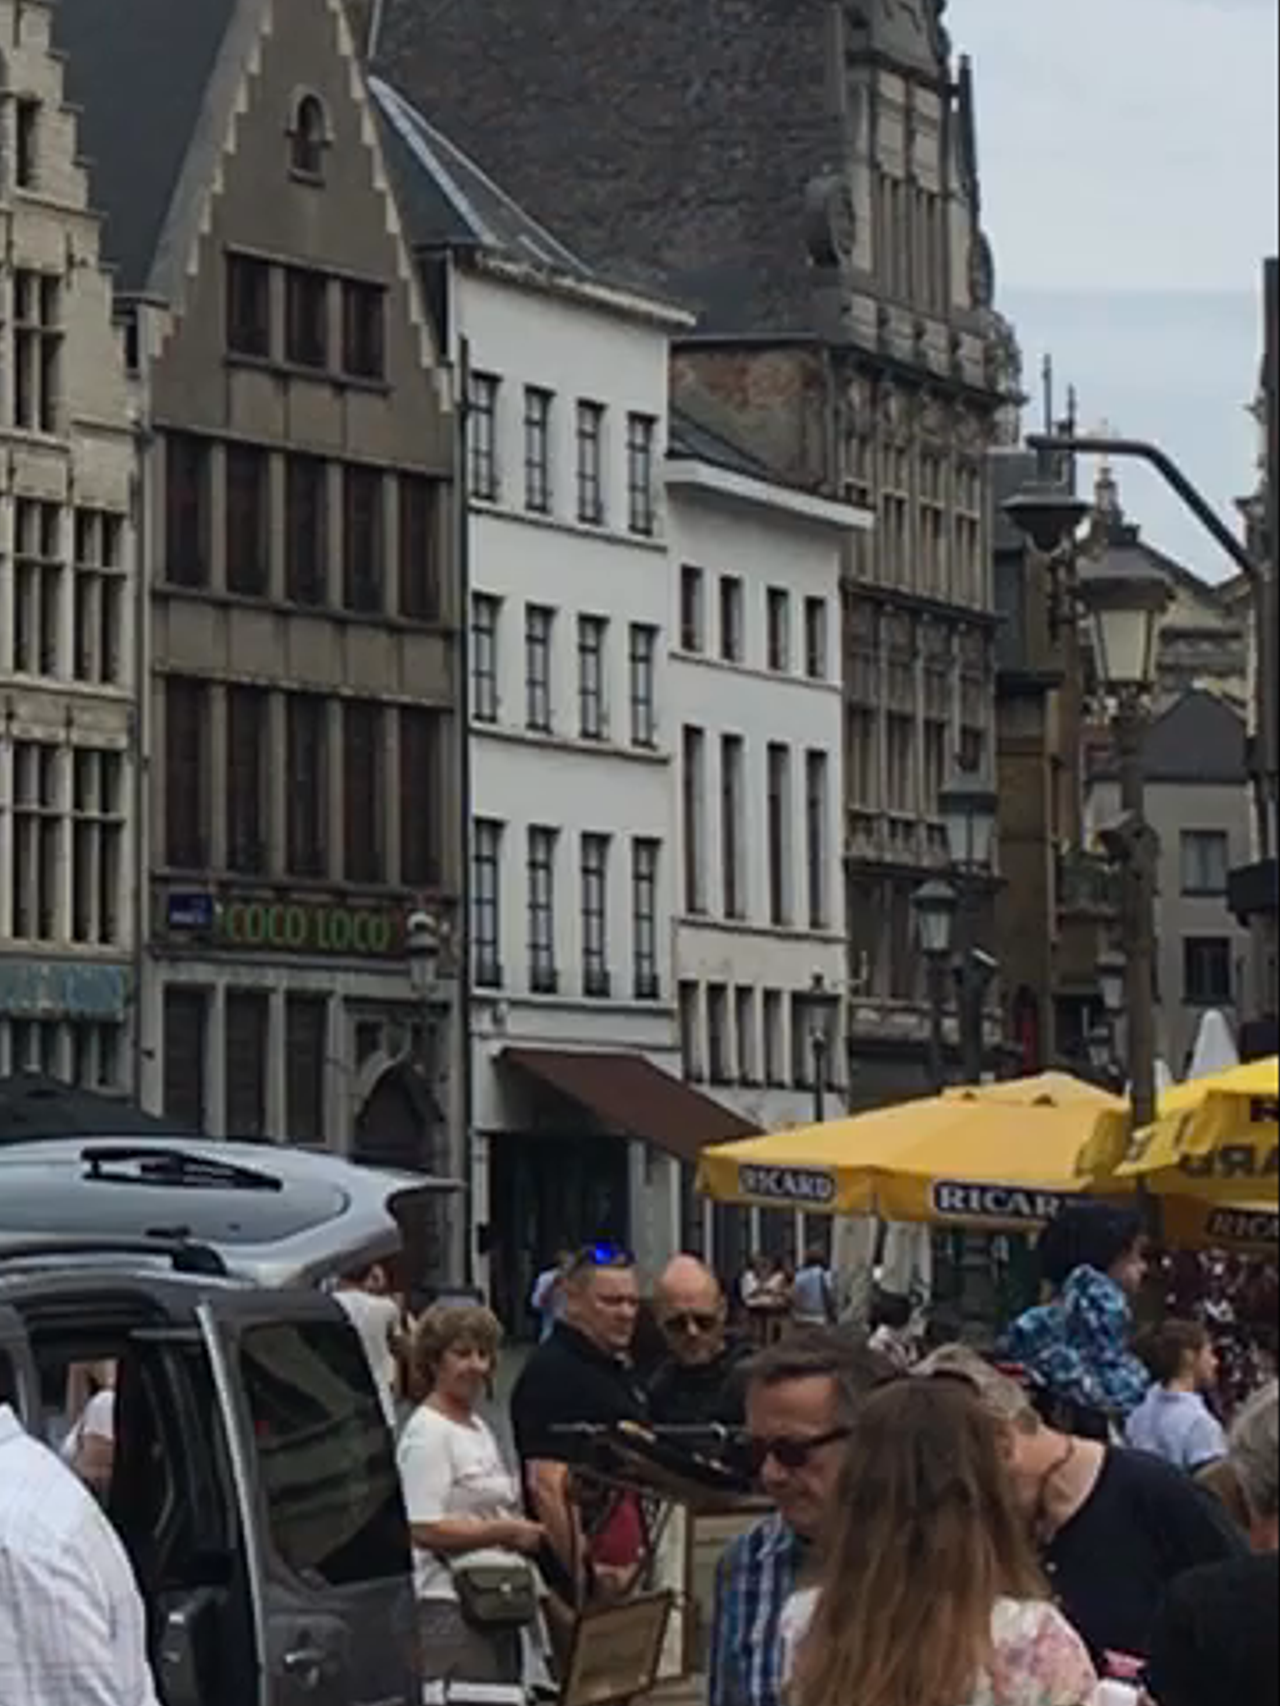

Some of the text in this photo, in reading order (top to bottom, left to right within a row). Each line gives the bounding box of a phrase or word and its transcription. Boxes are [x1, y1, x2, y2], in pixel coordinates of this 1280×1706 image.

[226, 901, 391, 952] COCO LOCO
[742, 1168, 831, 1200] RICARD
[940, 1185, 1061, 1218] RICAR
